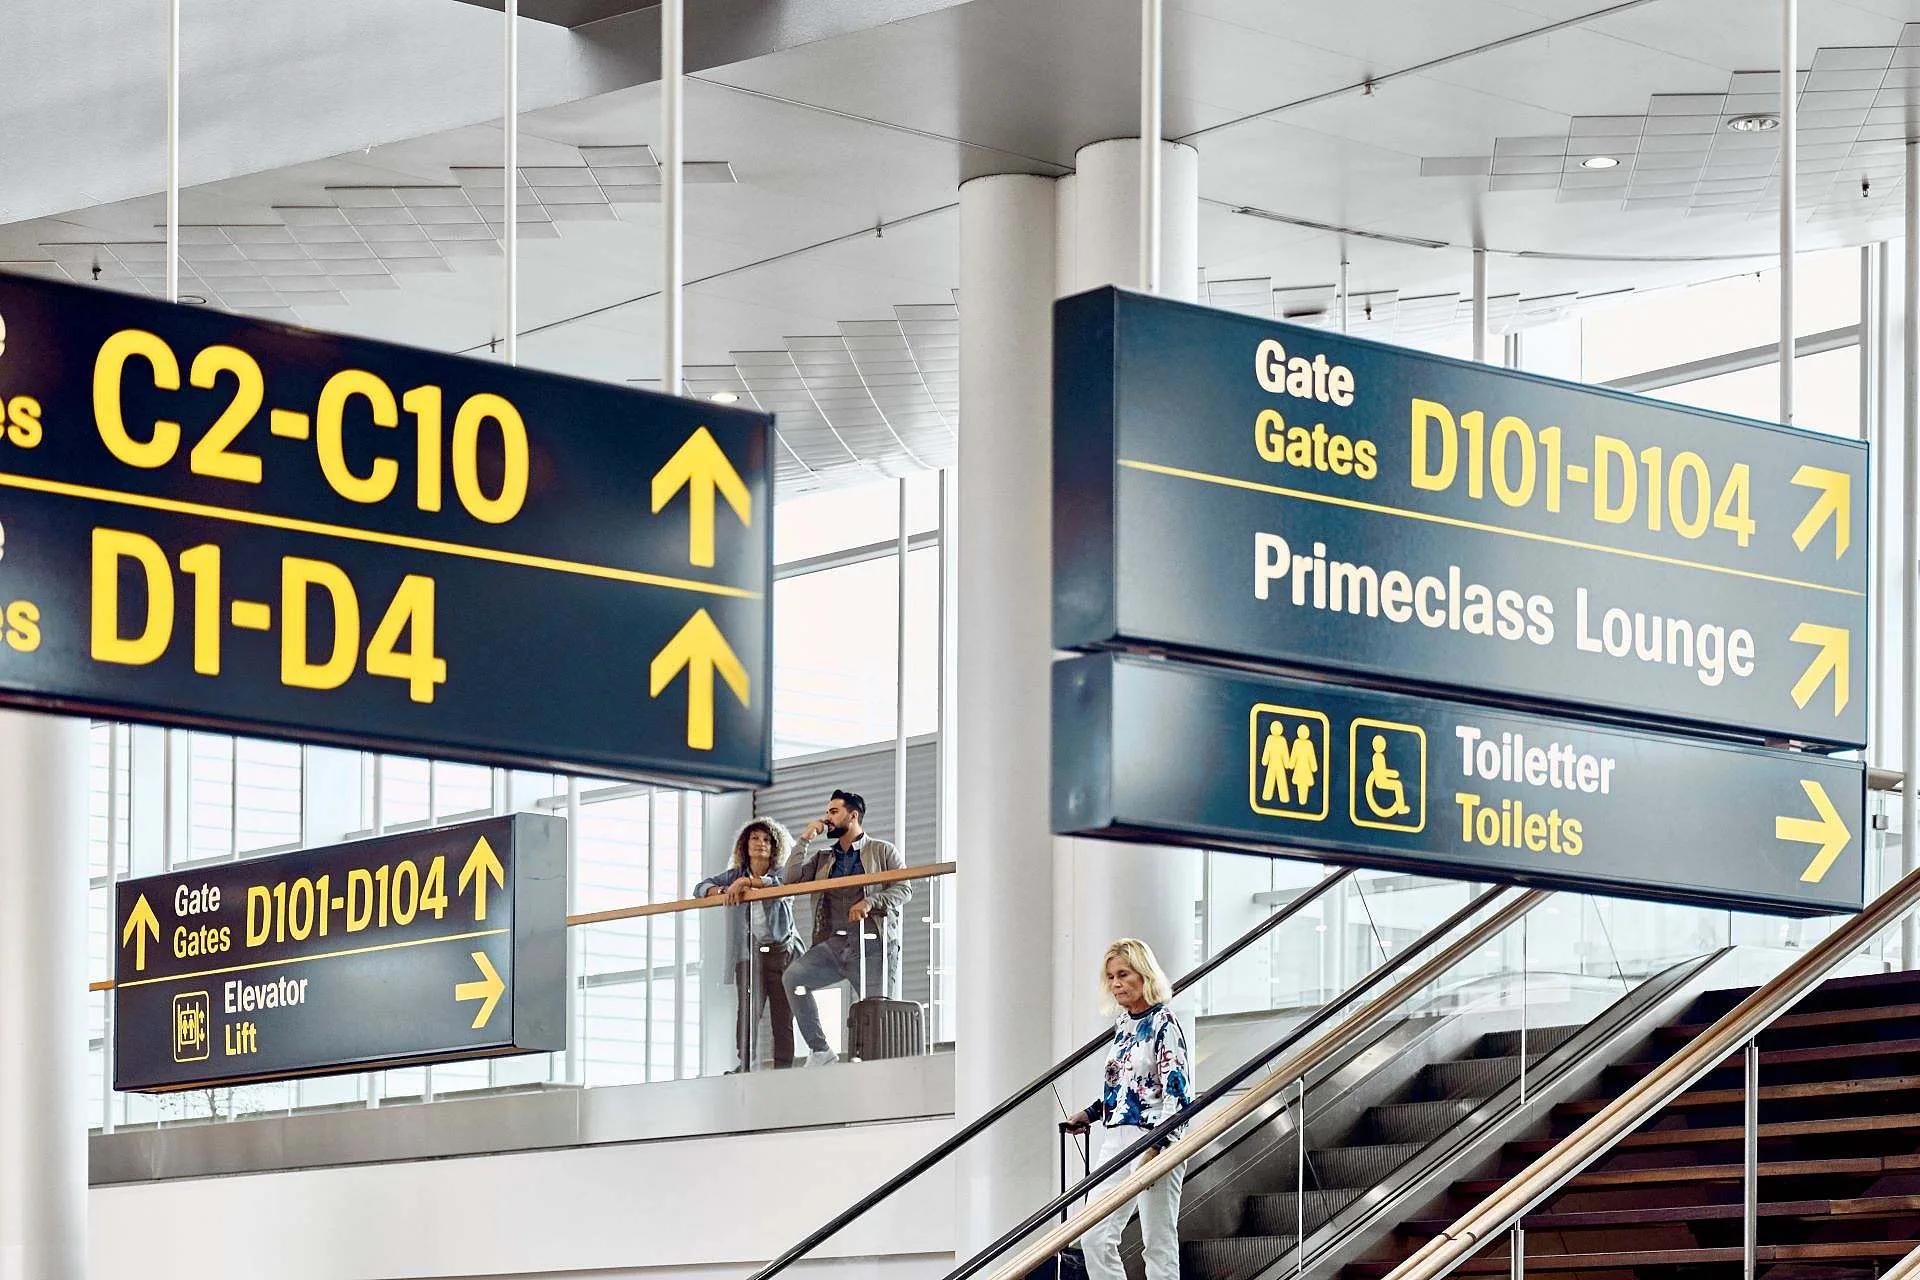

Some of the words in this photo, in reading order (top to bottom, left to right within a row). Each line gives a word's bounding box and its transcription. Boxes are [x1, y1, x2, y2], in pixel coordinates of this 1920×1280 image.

[1255, 339, 1355, 407] Gate
[0, 397, 43, 448] s
[93, 329, 529, 524] C2-C10
[1254, 409, 1378, 480] Gates
[1411, 398, 1756, 549] D101-D104
[0, 601, 41, 652] s
[91, 528, 446, 703] D1-D4
[1254, 532, 1555, 646] Primeclass
[1576, 587, 1756, 687] Lounge
[1455, 725, 1616, 795] Toiletter
[1455, 792, 1584, 857] Toilets
[174, 883, 221, 917] Gate
[246, 855, 448, 948] D101-D104
[173, 924, 231, 959] Gates
[224, 976, 308, 1014] Elevator
[225, 1021, 257, 1056] Lift
